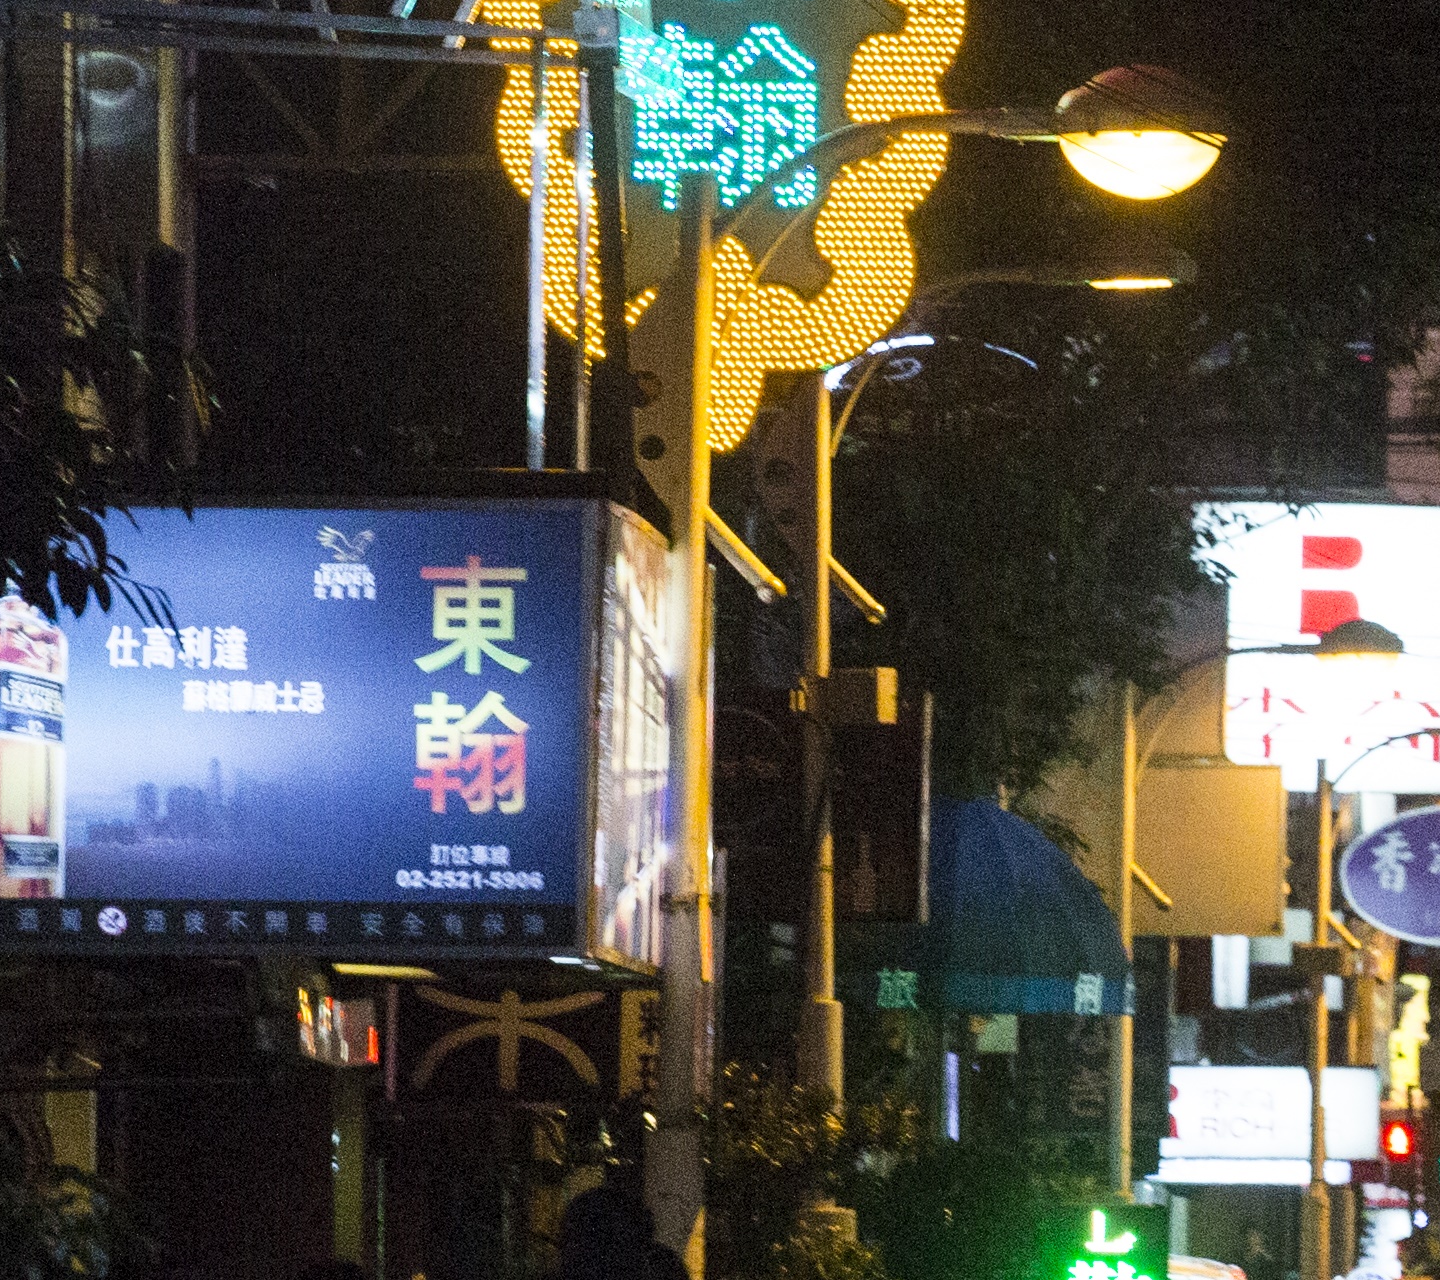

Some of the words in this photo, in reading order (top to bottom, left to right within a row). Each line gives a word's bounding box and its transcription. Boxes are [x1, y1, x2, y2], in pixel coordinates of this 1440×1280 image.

[106, 623, 250, 672] 仕高利達
[181, 678, 326, 716] 蘇格蘭威士忌
[412, 554, 532, 816] 東翰
